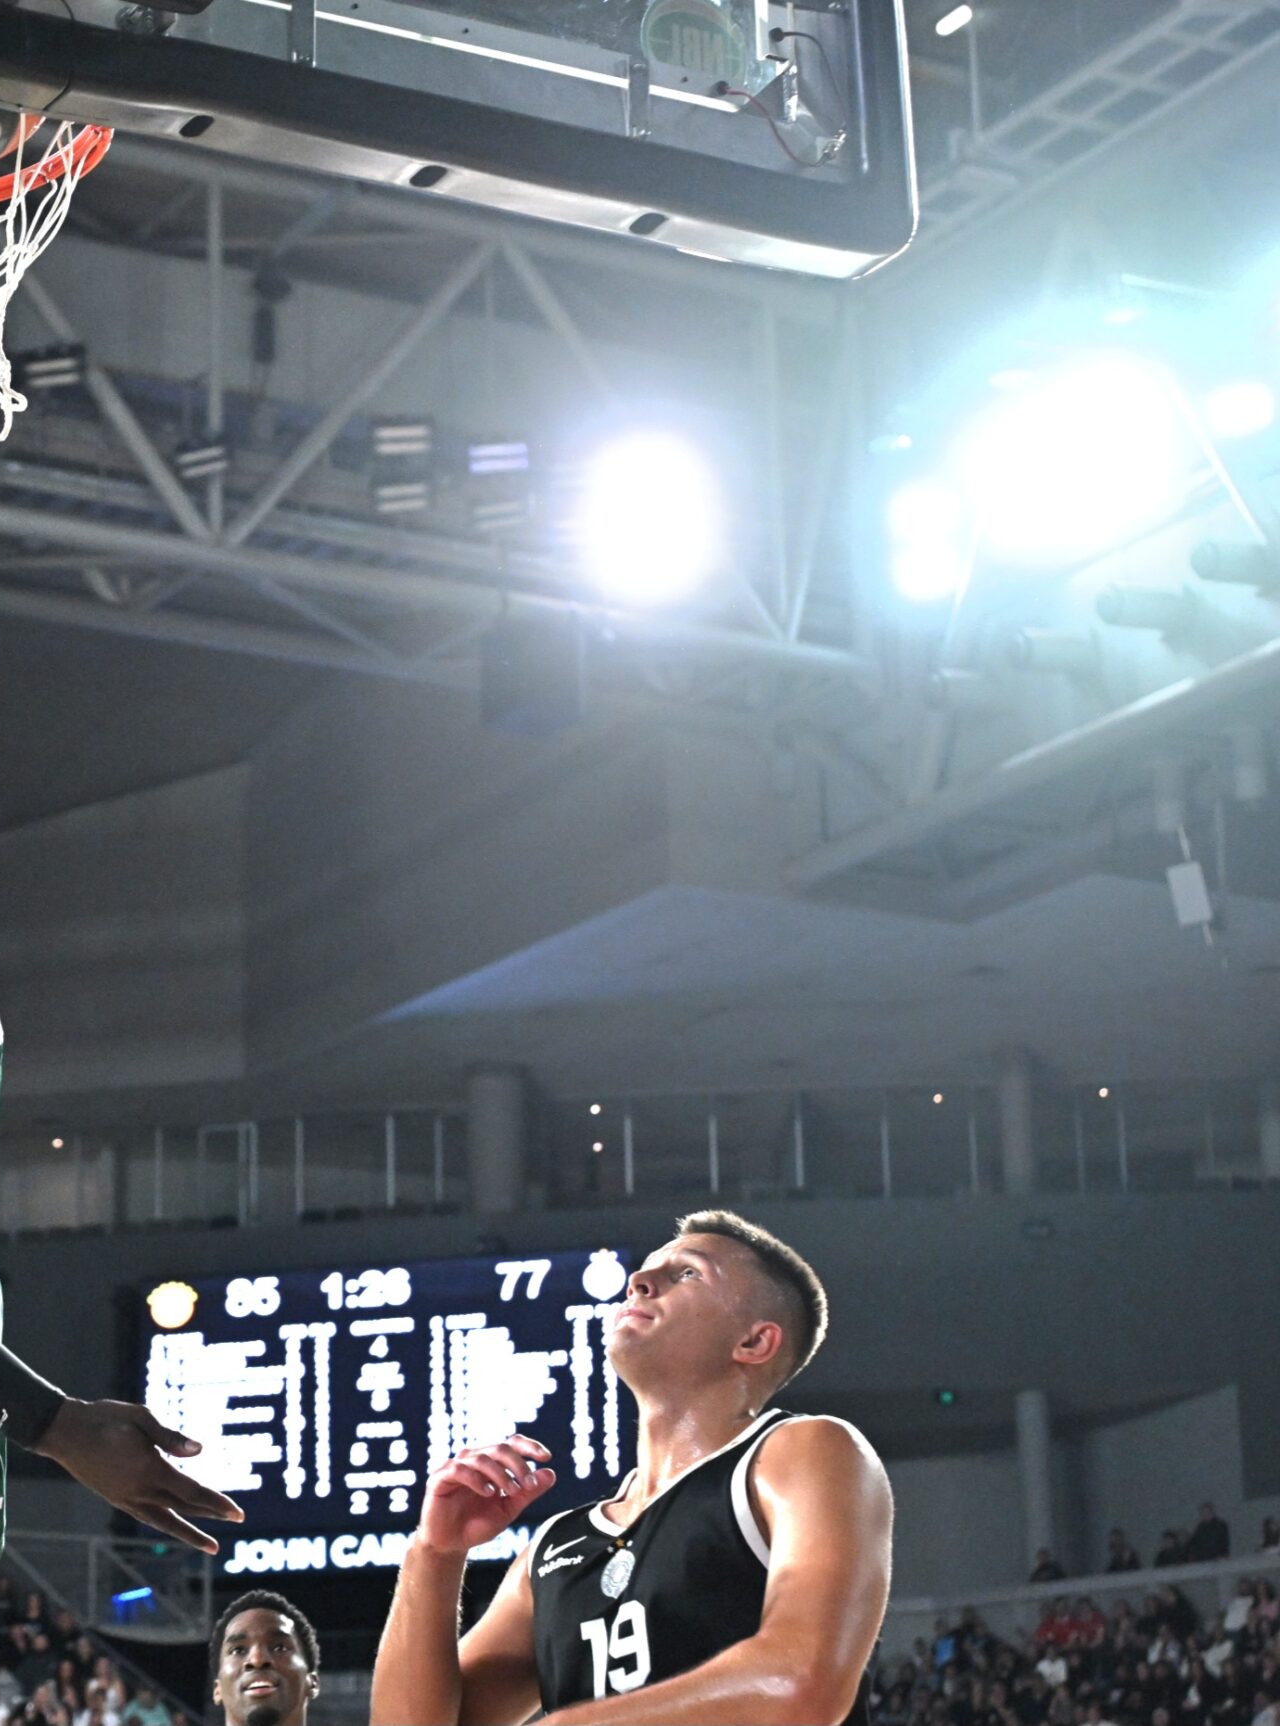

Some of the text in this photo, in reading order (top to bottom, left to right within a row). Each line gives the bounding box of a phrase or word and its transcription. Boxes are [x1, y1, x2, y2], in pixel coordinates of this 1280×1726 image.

[495, 1259, 551, 1301] 77
[224, 1536, 325, 1574] JOHN
[580, 1599, 651, 1701] 19
